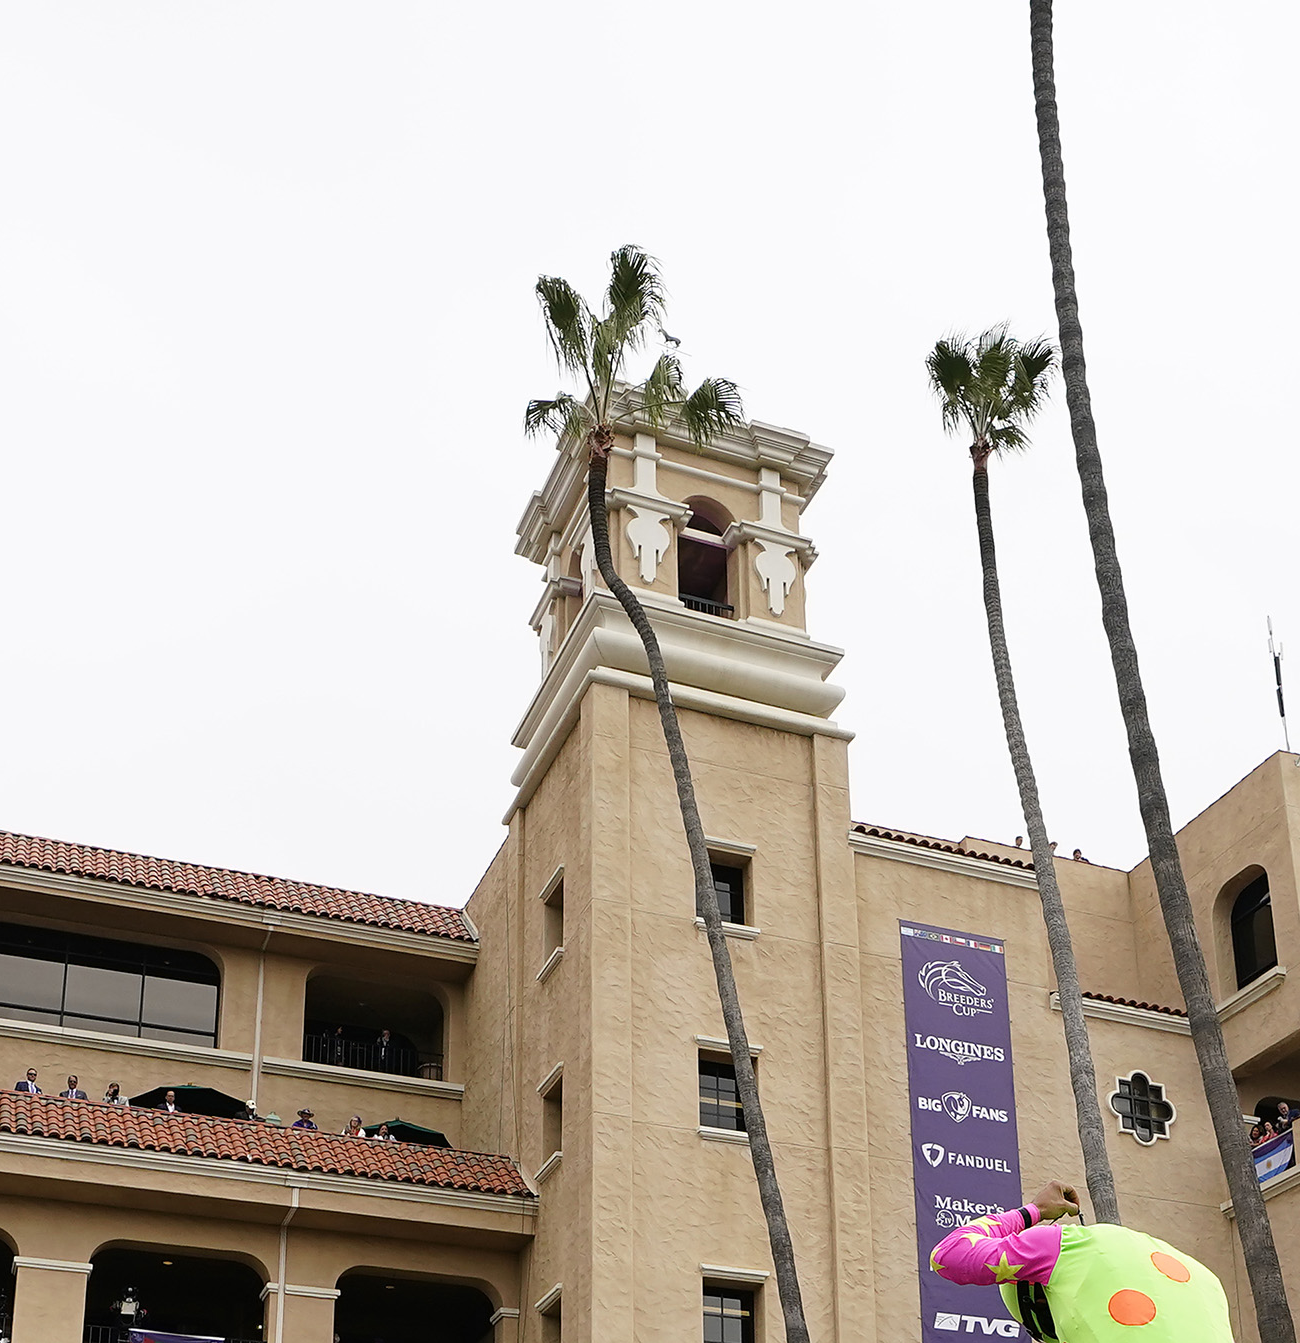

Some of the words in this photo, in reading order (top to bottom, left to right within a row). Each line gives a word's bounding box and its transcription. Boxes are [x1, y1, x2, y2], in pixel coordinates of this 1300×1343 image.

[938, 989, 994, 1010] BREEDERS'
[952, 1004, 977, 1017] CUP
[914, 1033, 1005, 1062] LONGINES
[918, 1096, 942, 1112] BIG
[972, 1105, 1009, 1123] FANS
[948, 1152, 1011, 1173] FANDUEL
[934, 1195, 1005, 1215] Maker's
[961, 1315, 1020, 1338] TVG
